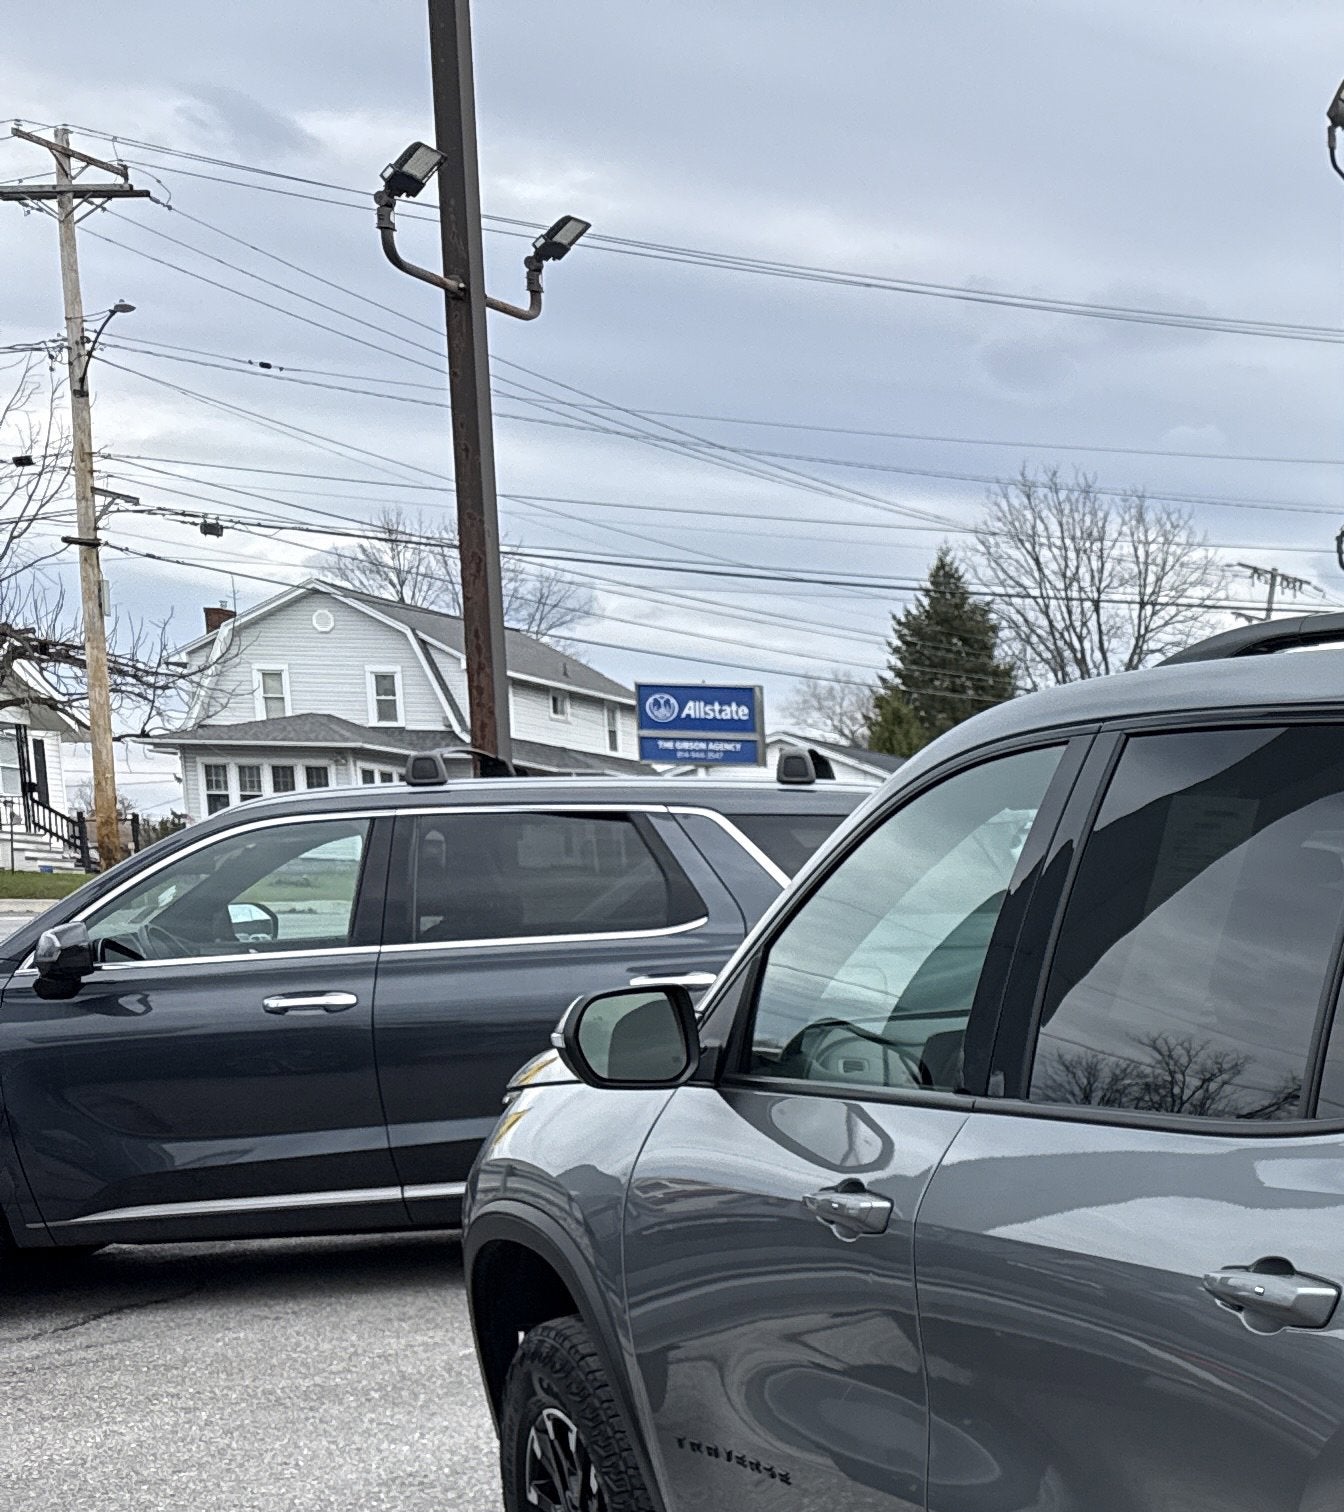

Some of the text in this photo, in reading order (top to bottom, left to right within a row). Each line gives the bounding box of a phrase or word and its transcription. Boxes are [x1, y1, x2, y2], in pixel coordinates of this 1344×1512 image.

[680, 700, 749, 720] Allstate
[657, 740, 674, 750] THE
[708, 741, 741, 752] AGENCY
